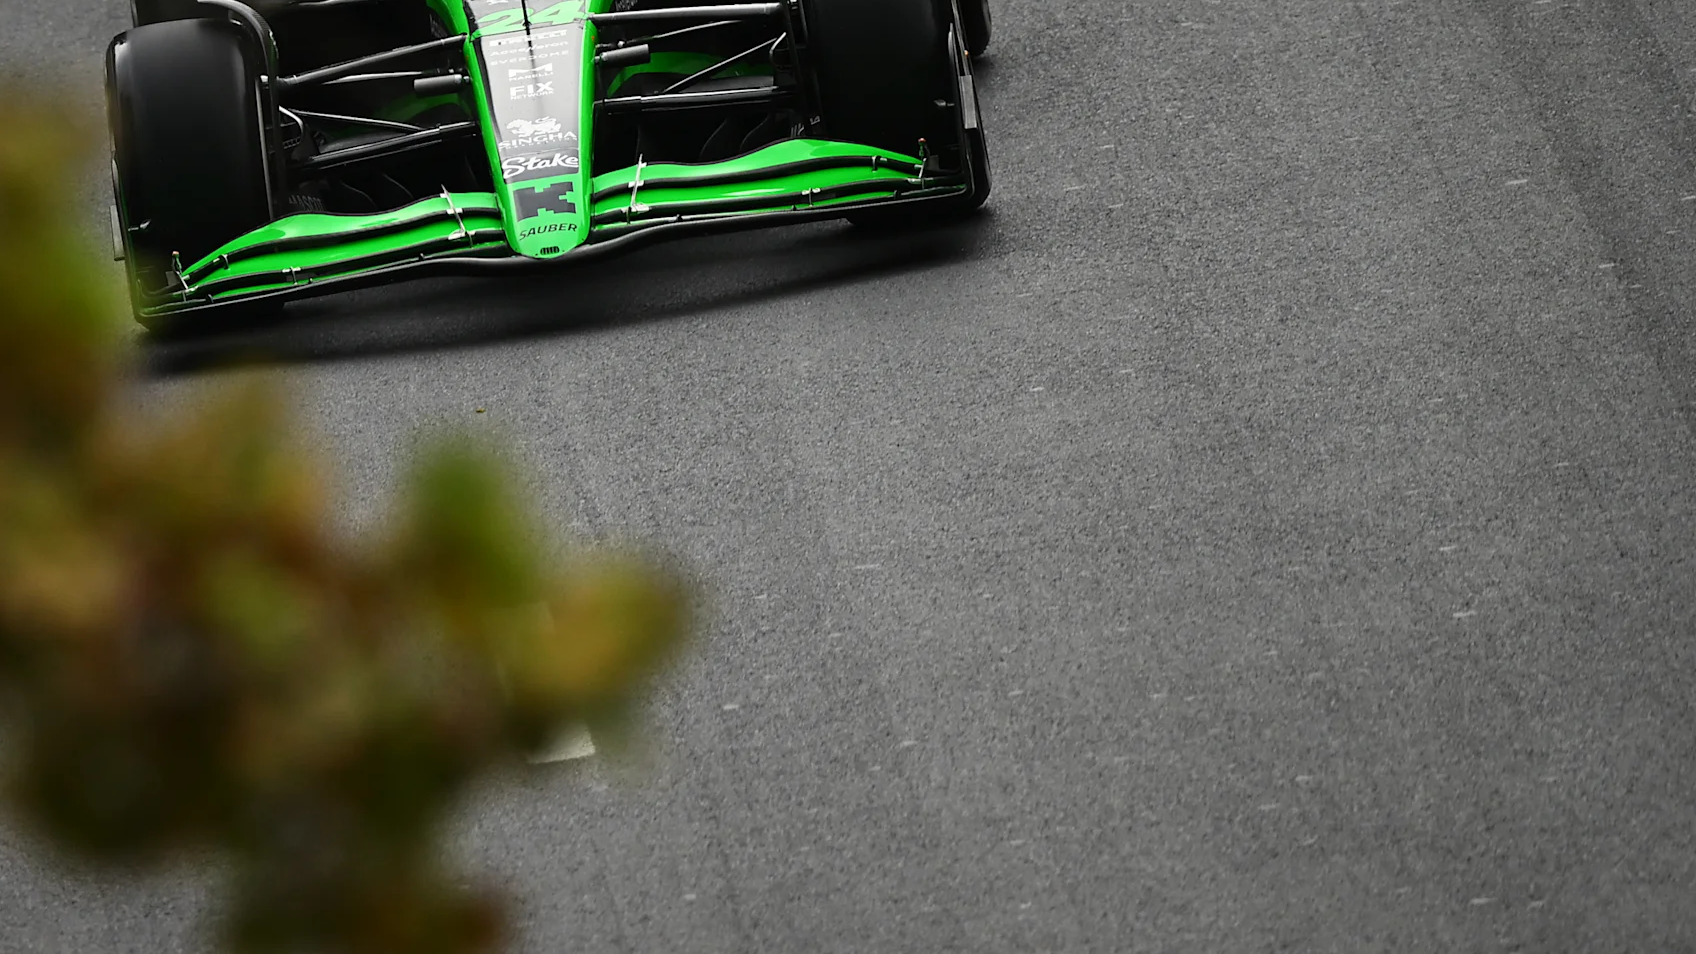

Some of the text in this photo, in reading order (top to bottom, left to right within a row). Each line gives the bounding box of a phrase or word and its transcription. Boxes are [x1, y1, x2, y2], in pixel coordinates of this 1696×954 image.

[470, 0, 590, 41] 24
[510, 80, 553, 97] FIX
[498, 130, 578, 148] SINGHA
[501, 153, 579, 180] Stake
[519, 222, 578, 241] SAUBER
